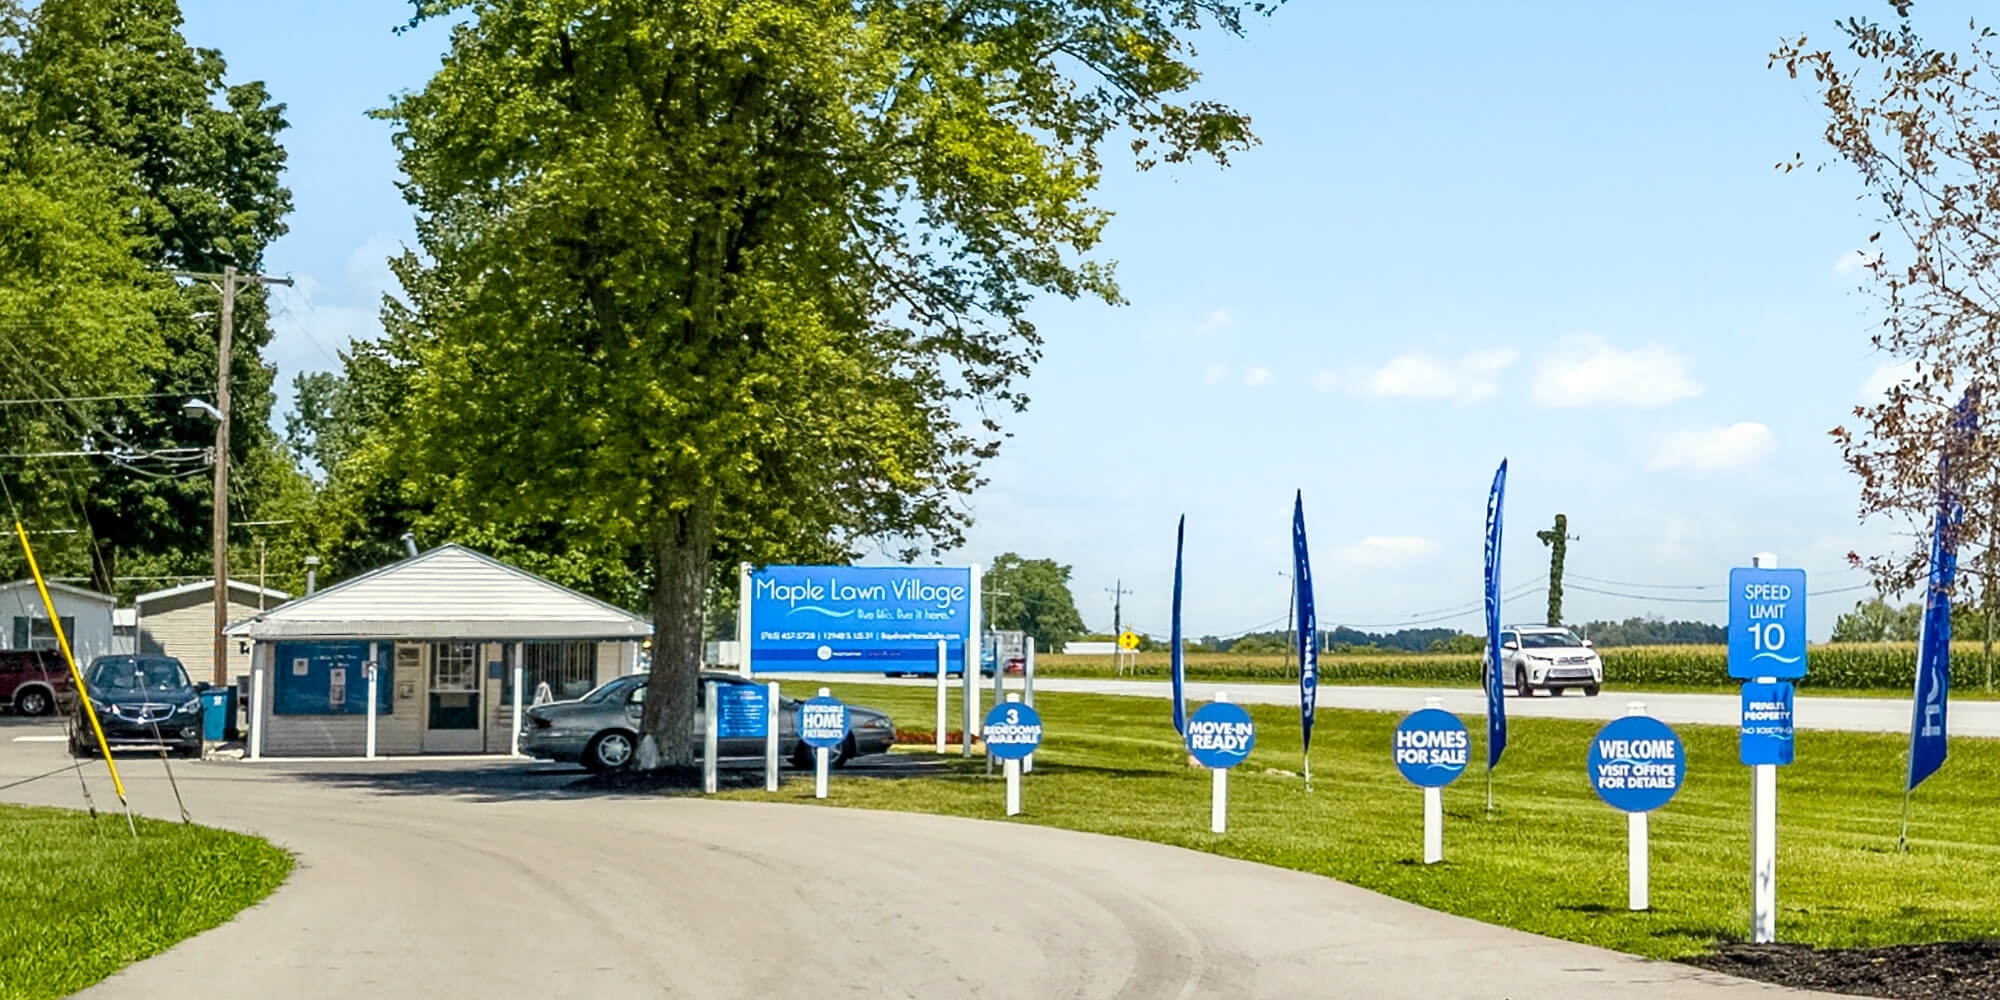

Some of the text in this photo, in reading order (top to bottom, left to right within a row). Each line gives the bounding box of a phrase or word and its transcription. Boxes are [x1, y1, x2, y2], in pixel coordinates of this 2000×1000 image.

[757, 578, 965, 608] Maple Lawn Village
[1744, 583, 1791, 600] SPEED
[1750, 603, 1786, 619] LIMIT
[1747, 622, 1786, 651] 10
[803, 713, 844, 729] HOME
[1006, 708, 1019, 724] 3
[1744, 711, 1791, 720] PROPERTY
[983, 725, 1041, 735] BEDROOMS
[1188, 721, 1253, 736] MOVE-IN
[986, 734, 1039, 745] AVAILABLE
[1192, 735, 1249, 750] READY
[1397, 730, 1467, 748] HOMES
[1397, 749, 1467, 764] FOR SALE
[1599, 740, 1675, 759] WELCOME
[1598, 764, 1676, 777] VISIT OFFICE
[1598, 777, 1676, 789] FOR DETAILS
